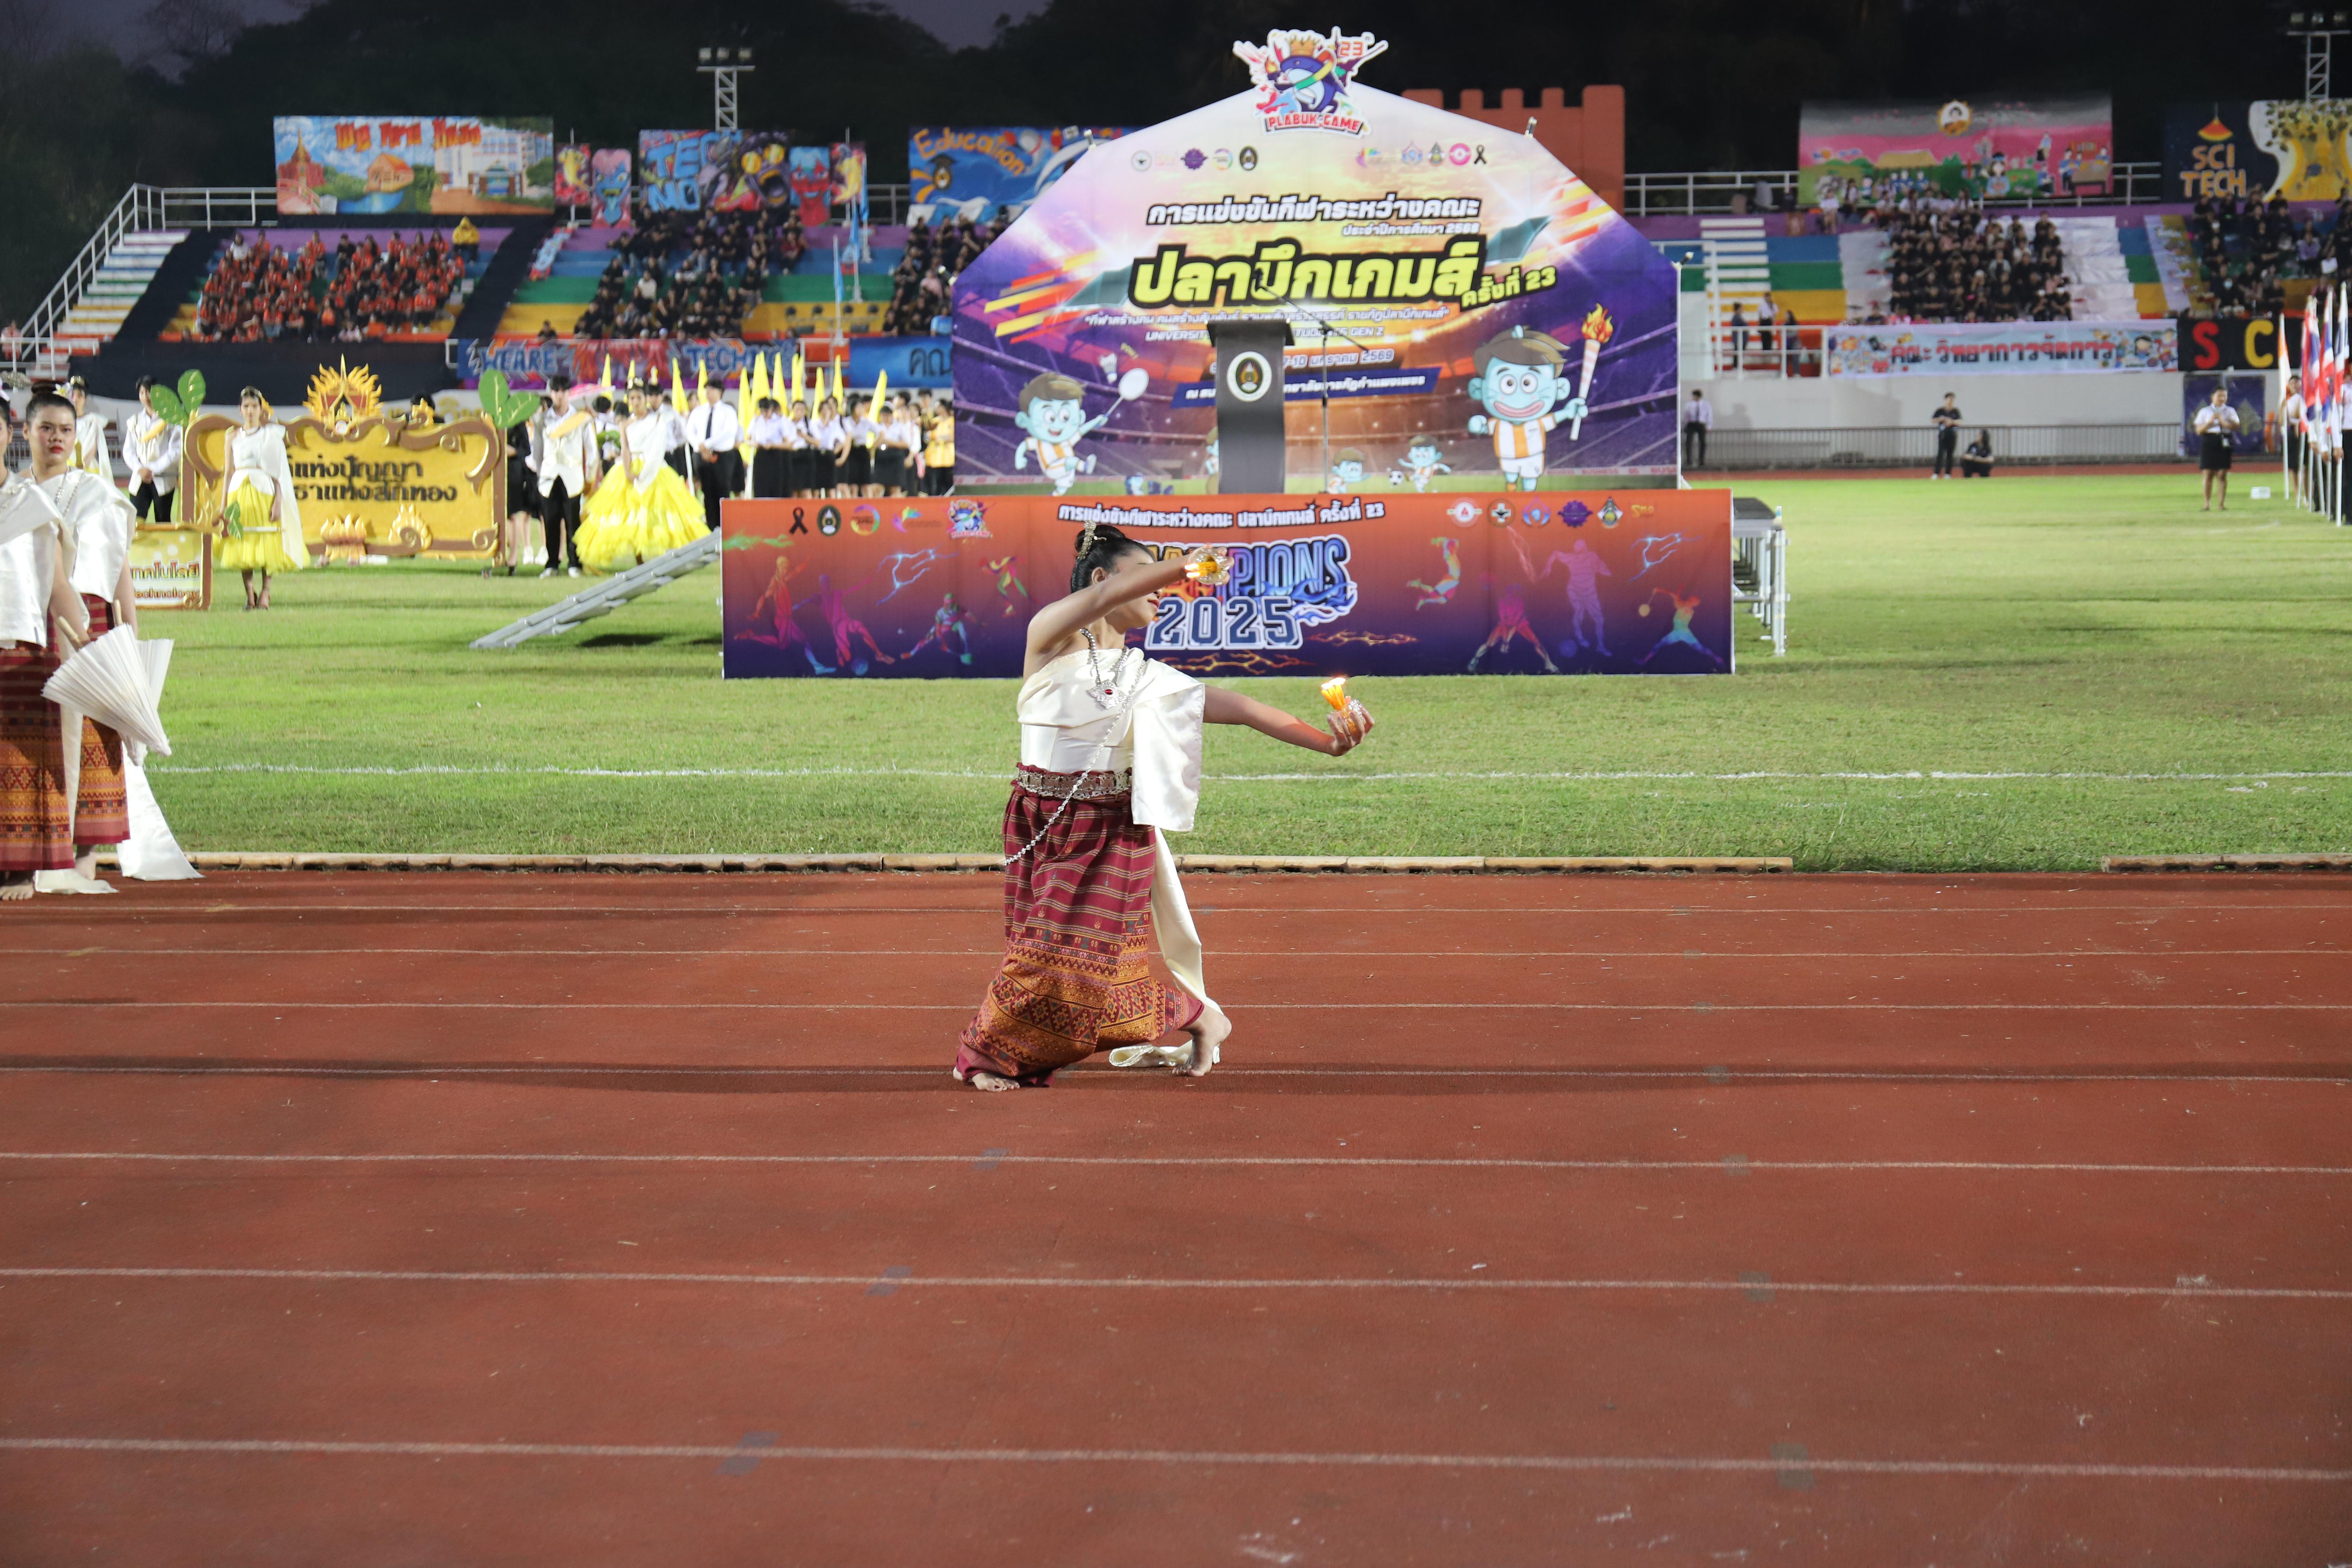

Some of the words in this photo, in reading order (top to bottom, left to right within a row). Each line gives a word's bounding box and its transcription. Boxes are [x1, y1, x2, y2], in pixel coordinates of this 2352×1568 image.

[1338, 41, 1363, 57] 23
[1268, 112, 1318, 129] PLABUK
[1323, 115, 1362, 132] GAME
[2192, 143, 2235, 170] SCI
[2179, 168, 2246, 198] TECH
[1147, 192, 1481, 225] การแข่งขันกีฬาระหว่างคณะ
[1132, 238, 1482, 304] ปลาบึกเกมส์
[1462, 274, 1521, 308] ครั้งที่
[1527, 267, 1556, 289] 23
[1350, 326, 1374, 336] GEN
[1376, 326, 1385, 336] Z
[2192, 321, 2220, 369] S
[2244, 319, 2274, 368] C
[909, 347, 953, 376] คณ
[1360, 348, 1395, 364] 2569
[1058, 503, 1233, 528] การแข่งขันกีฬาระหว่างคณะ
[1237, 503, 1316, 528] ปลาบึกเกมส์
[1320, 497, 1362, 523] ครั้งที่
[1365, 502, 1385, 519] 23
[130, 560, 199, 580] ทคโนโลยี
[1147, 597, 1302, 649] 2025
